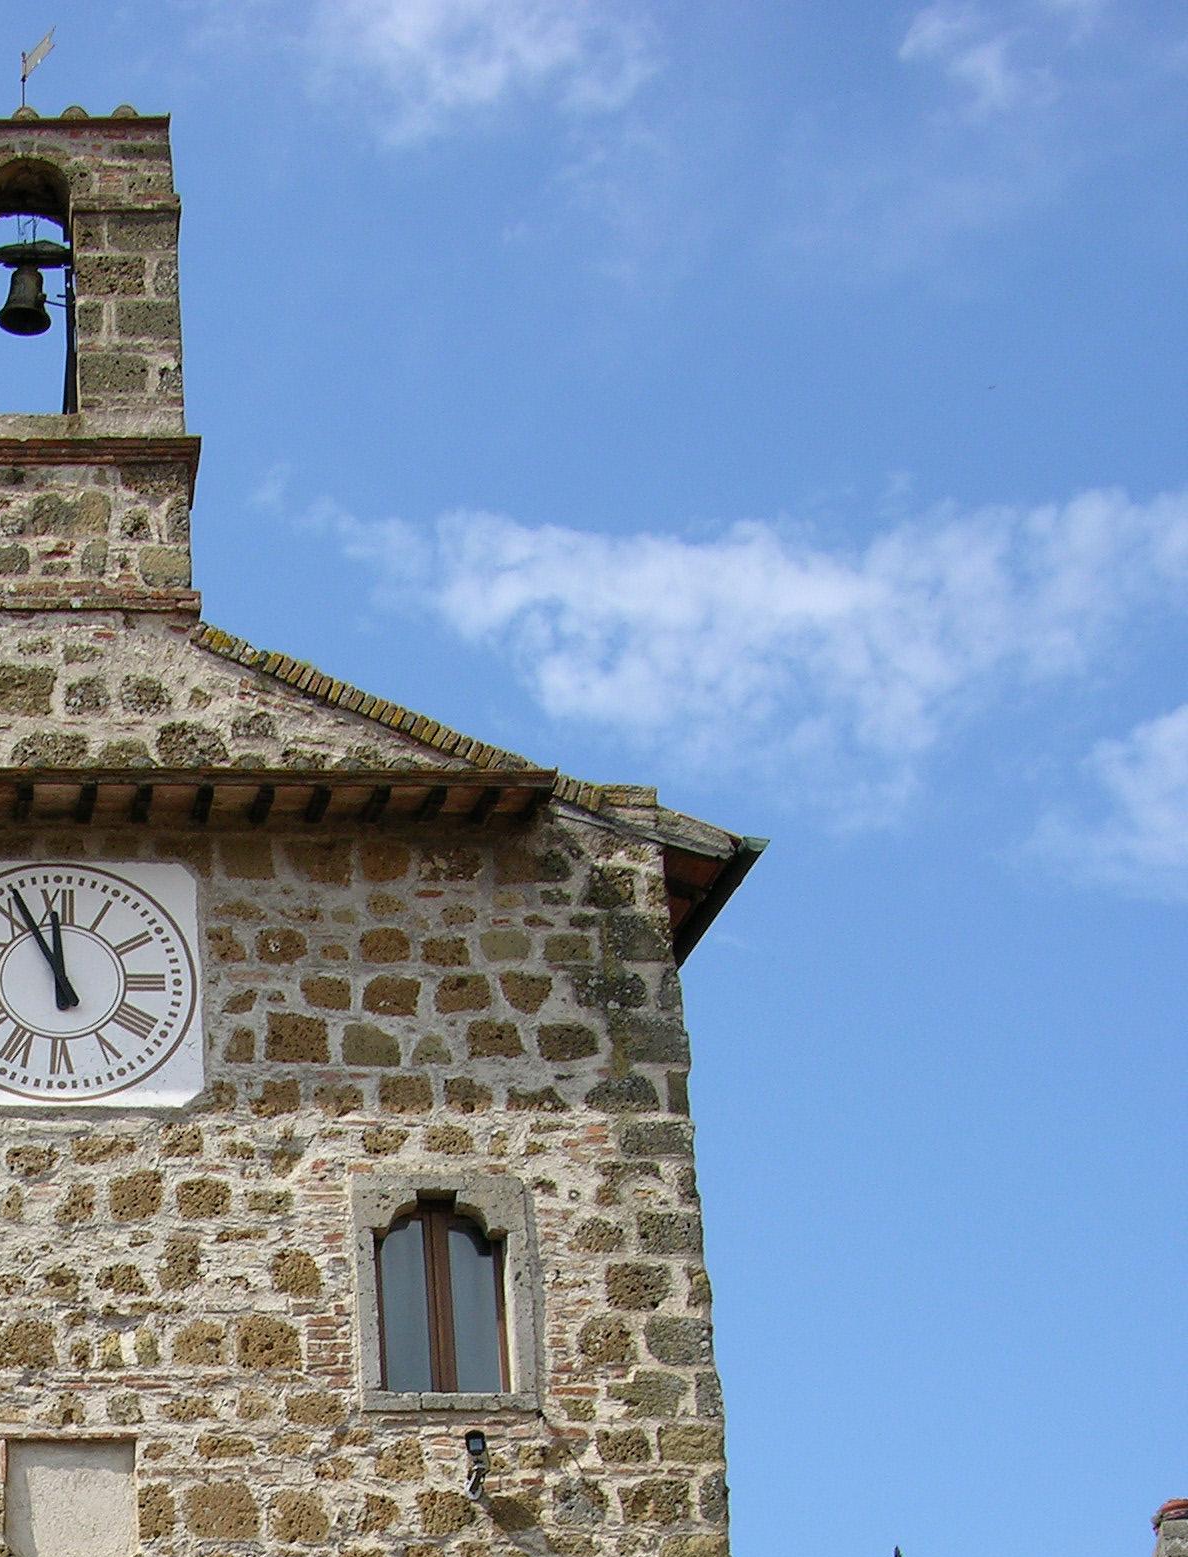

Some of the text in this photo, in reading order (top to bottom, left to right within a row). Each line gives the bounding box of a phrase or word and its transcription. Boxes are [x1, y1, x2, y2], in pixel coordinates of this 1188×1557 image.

[41, 889, 75, 925] XII
[90, 900, 113, 931] I
[114, 930, 154, 956] II
[126, 974, 166, 991] III
[112, 1002, 159, 1039] IIII
[49, 1038, 74, 1074] VI
[95, 1032, 123, 1065] V
